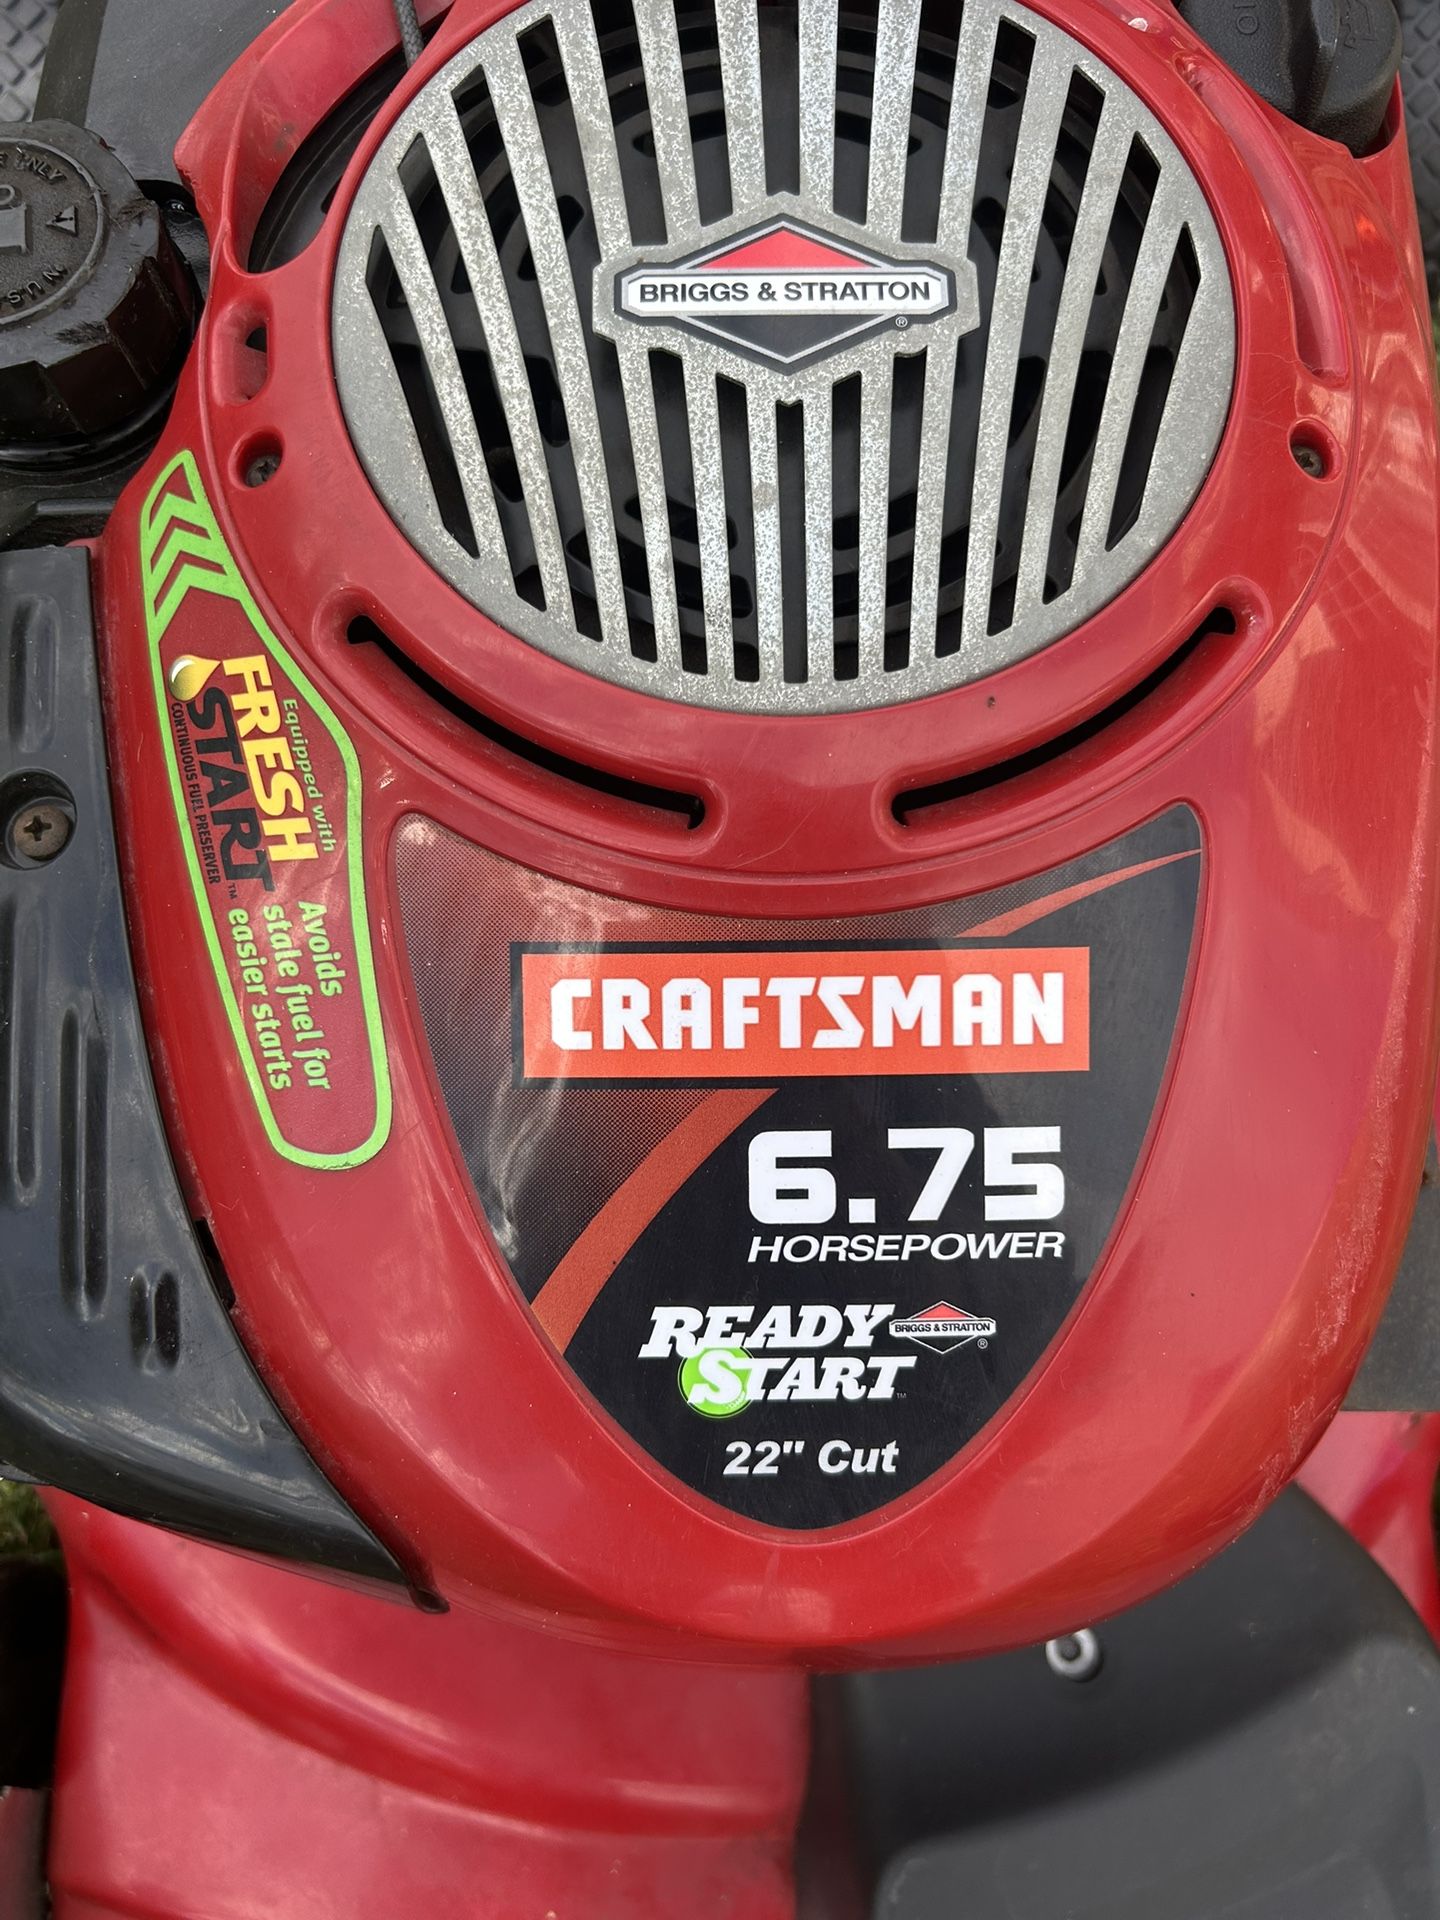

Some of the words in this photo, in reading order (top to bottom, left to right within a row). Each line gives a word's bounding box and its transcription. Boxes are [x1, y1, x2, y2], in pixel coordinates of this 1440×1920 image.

[639, 281, 748, 303] BRIGGS
[757, 281, 777, 301] &
[783, 280, 931, 302] STRATTON
[171, 702, 198, 784] CONTINUOUS
[222, 654, 319, 862] FRESH
[283, 698, 323, 798] Equipped
[312, 804, 337, 852] with
[186, 686, 275, 892] START
[187, 784, 204, 813] FUEL
[194, 813, 221, 885] PRESERVER
[263, 904, 302, 977] stale
[298, 901, 346, 997] Avoids
[228, 908, 268, 996] easier
[251, 1003, 293, 1090] starts
[275, 983, 325, 1043] fuel
[550, 972, 1065, 1051] CRAFTSMAN
[292, 1047, 331, 1090] for
[747, 1126, 1066, 1225] 6.75
[747, 1231, 1066, 1264] HORSEPOWER
[637, 1304, 896, 1359] READY
[895, 1323, 929, 1333] BRIGGS
[933, 1323, 941, 1333] &
[942, 1323, 990, 1333] STRATTON
[687, 1349, 918, 1405] START
[722, 1440, 804, 1476] 22"
[817, 1439, 900, 1474] Cut
